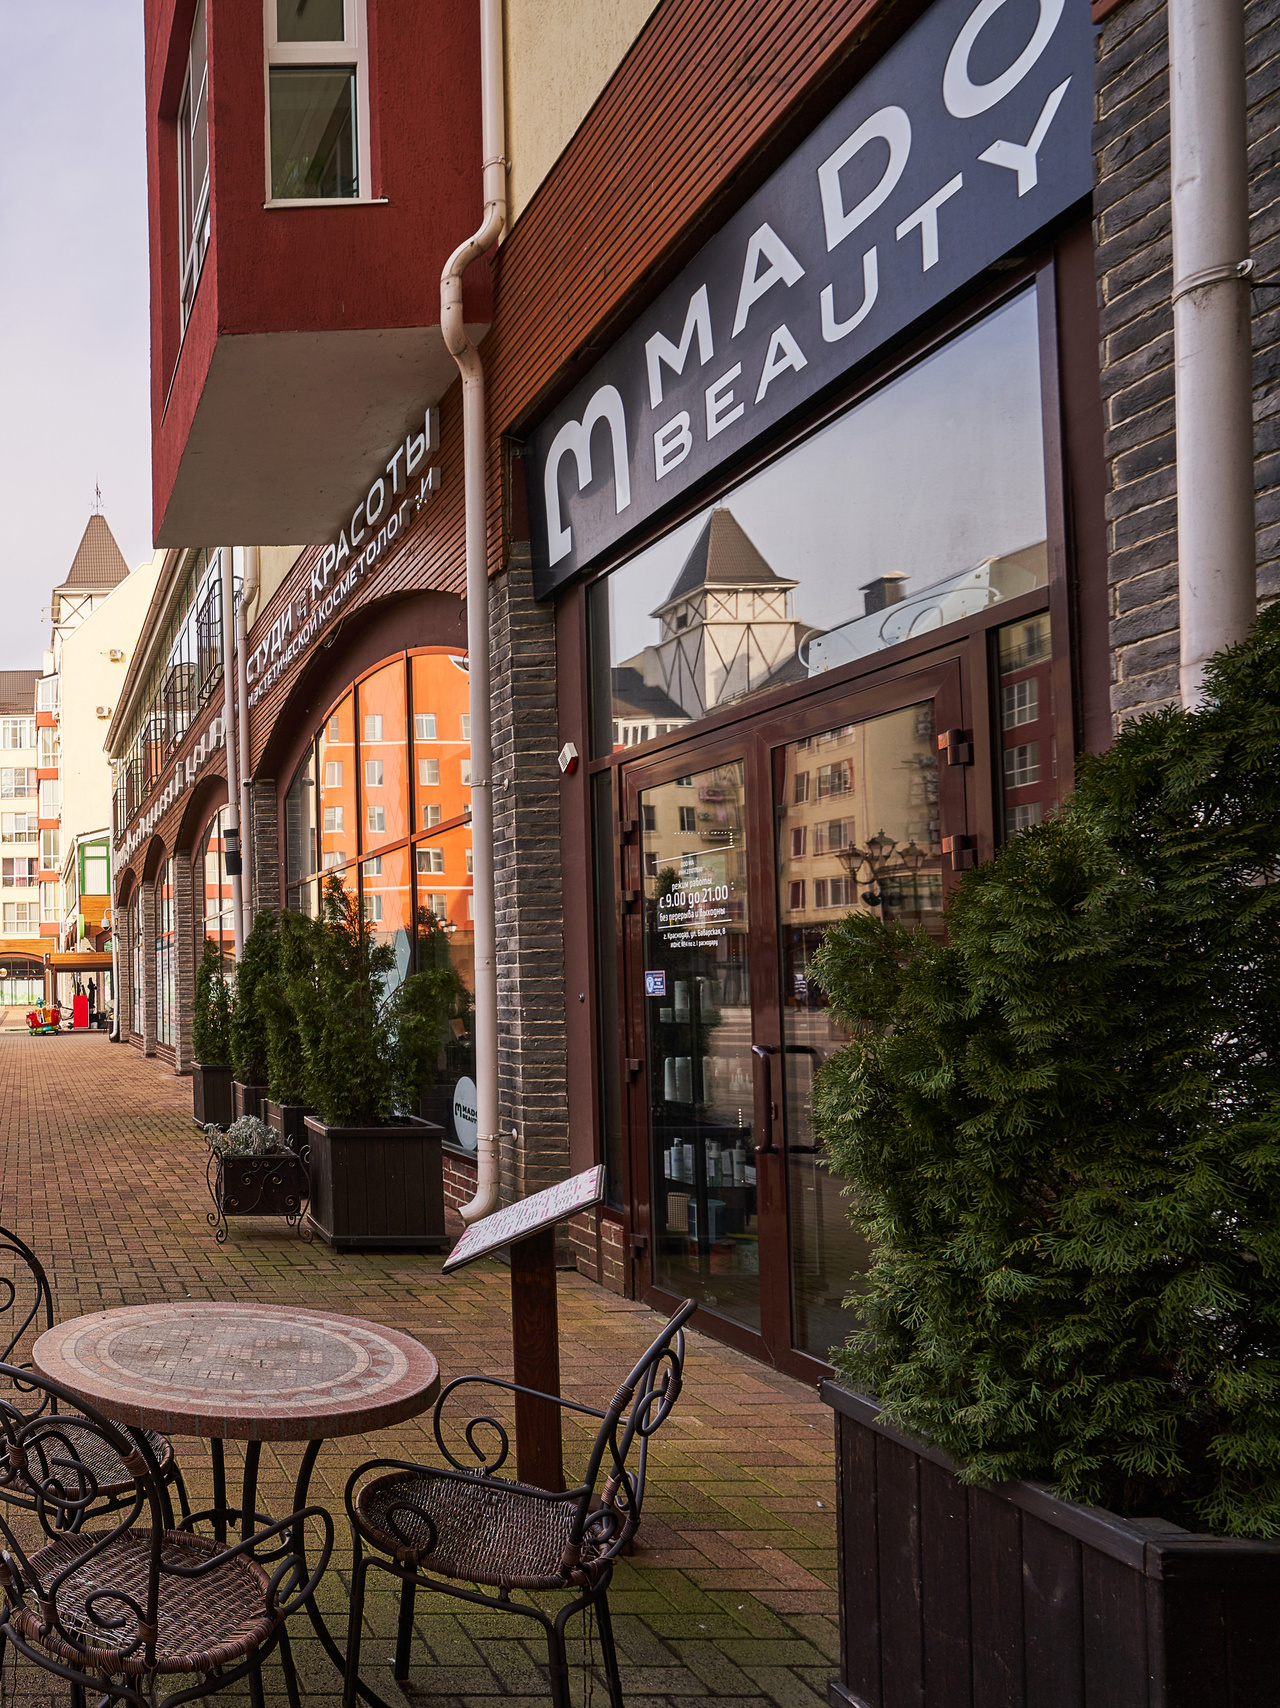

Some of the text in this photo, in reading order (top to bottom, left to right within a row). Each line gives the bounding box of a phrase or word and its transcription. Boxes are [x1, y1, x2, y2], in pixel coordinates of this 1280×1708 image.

[645, 0, 1065, 410] MADO
[653, 73, 1073, 482] BEAUTY
[311, 407, 431, 600] КРАСОТЫ
[254, 608, 317, 702] ЭСТЕТИЧЕСКОЙ
[319, 466, 432, 625] КОСМЕТОЛОГИ
[671, 877, 713, 892] режим работы
[665, 891, 686, 908] 9.00
[701, 885, 729, 903] 21.00
[659, 912, 668, 922] без
[668, 909, 695, 922] перерыва
[462, 1105, 478, 1118] MAD
[462, 1113, 478, 1124] BEAUT
